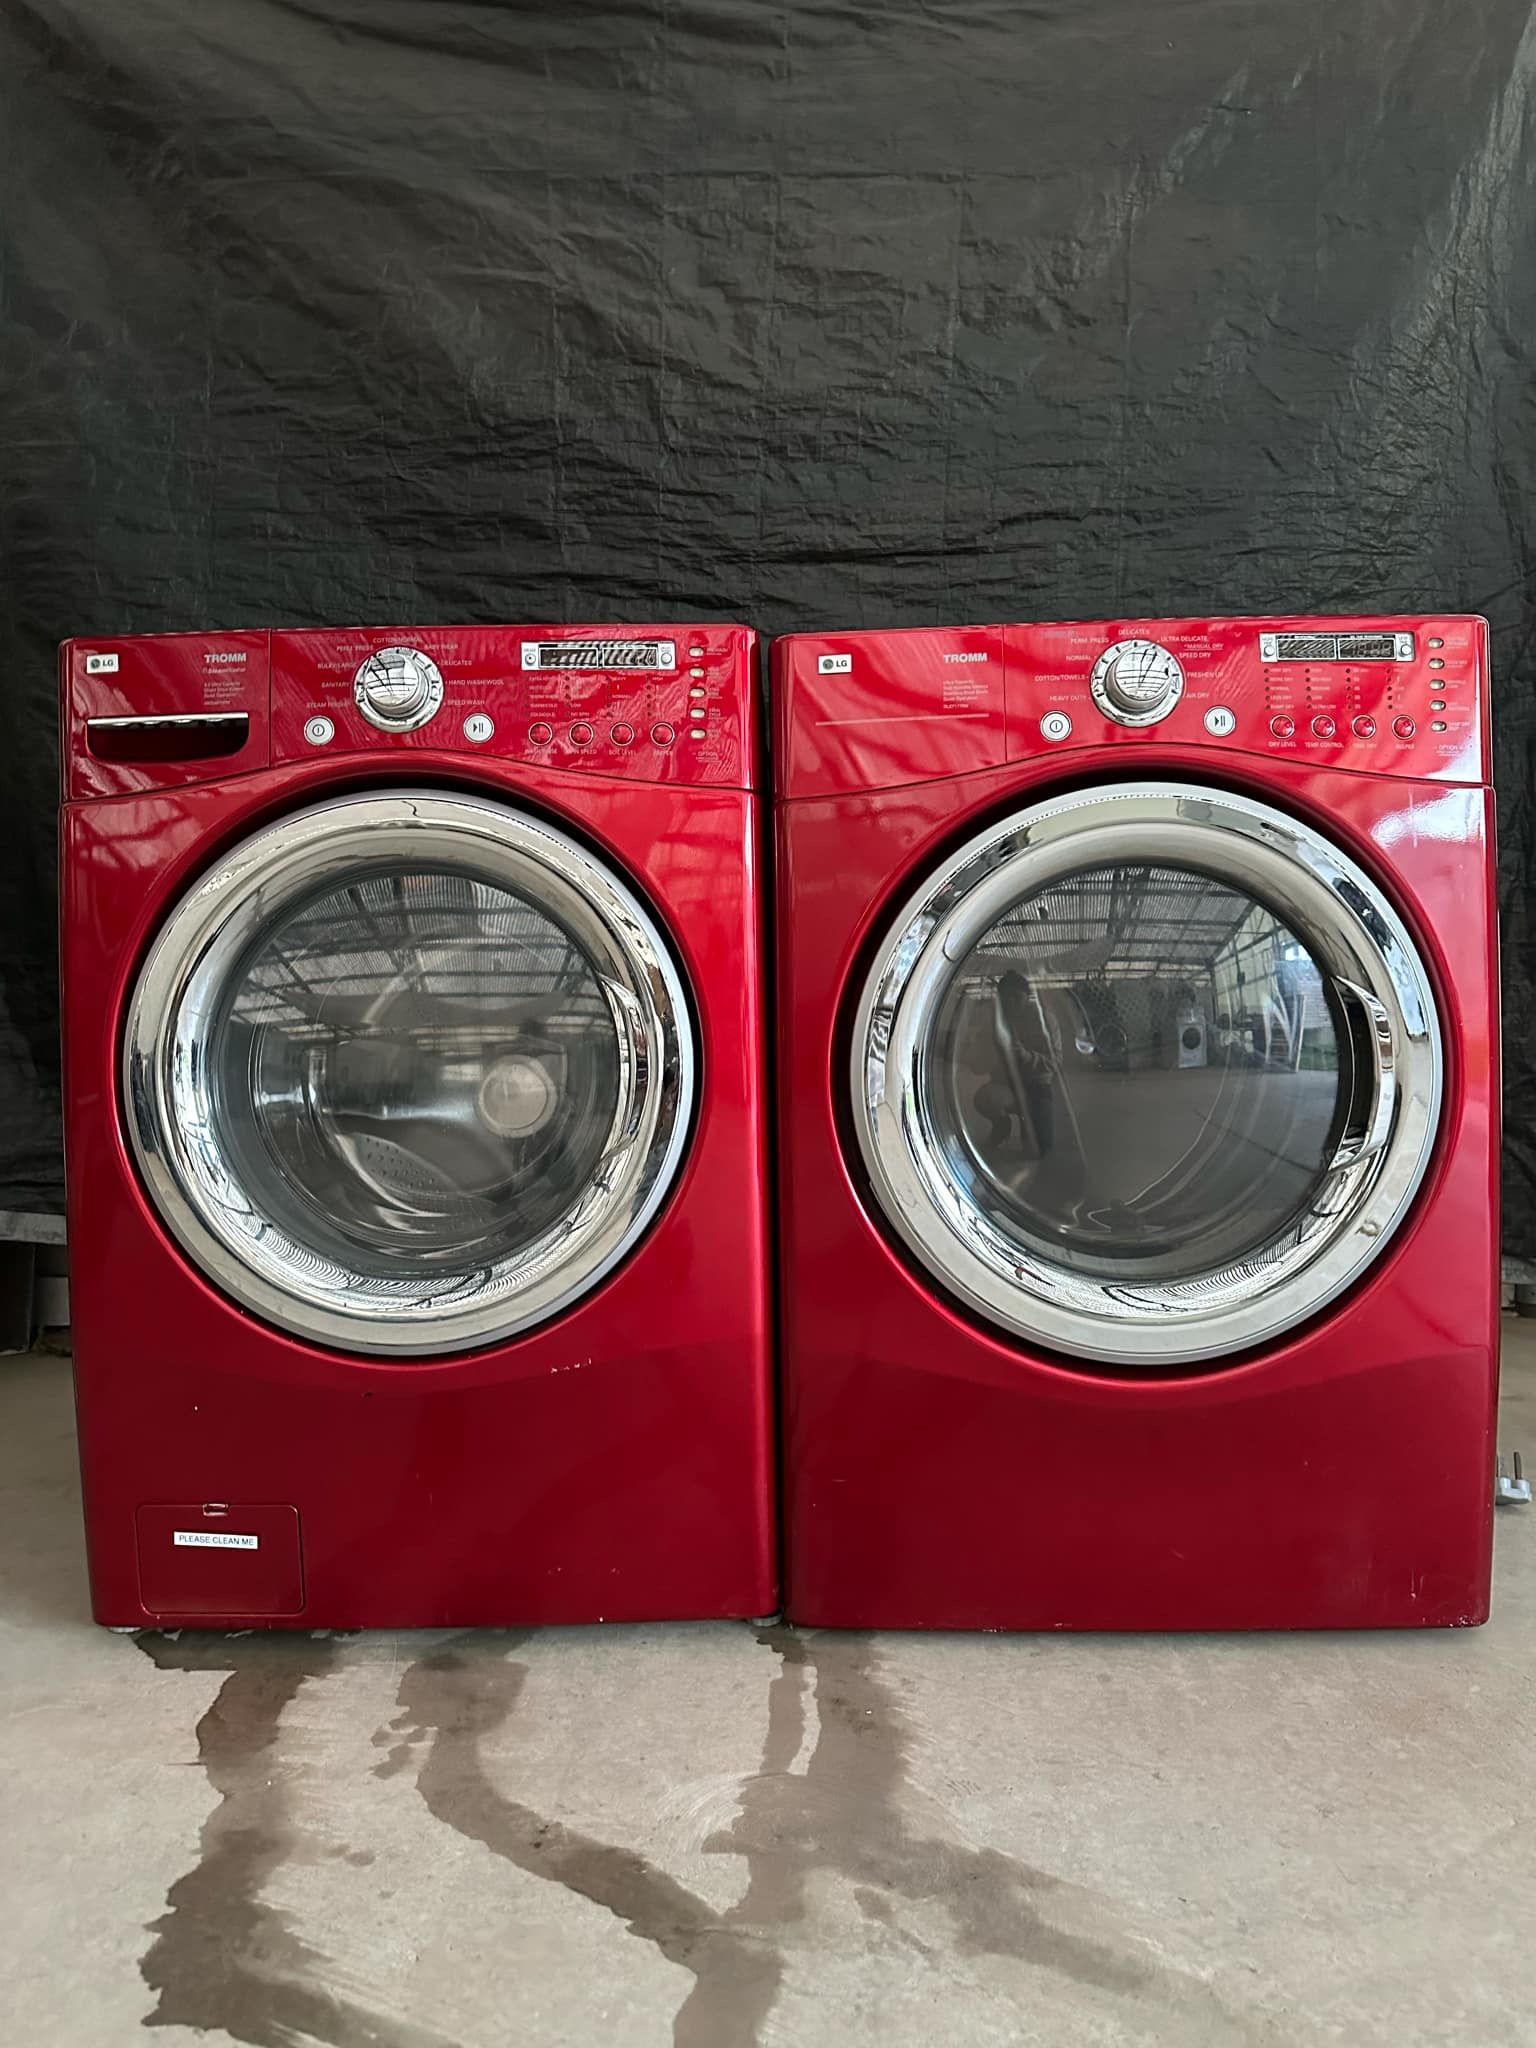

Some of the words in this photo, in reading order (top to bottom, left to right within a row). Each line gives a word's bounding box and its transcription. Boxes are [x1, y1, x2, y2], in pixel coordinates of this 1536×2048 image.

[102, 659, 114, 667] LG
[204, 653, 247, 664] TROMM
[943, 652, 988, 664] TROMM
[1034, 674, 1086, 682] COTTON/TOWELS
[179, 1534, 211, 1544] PLEASE
[212, 1536, 240, 1545] CLEAN
[241, 1538, 255, 1546] ME
